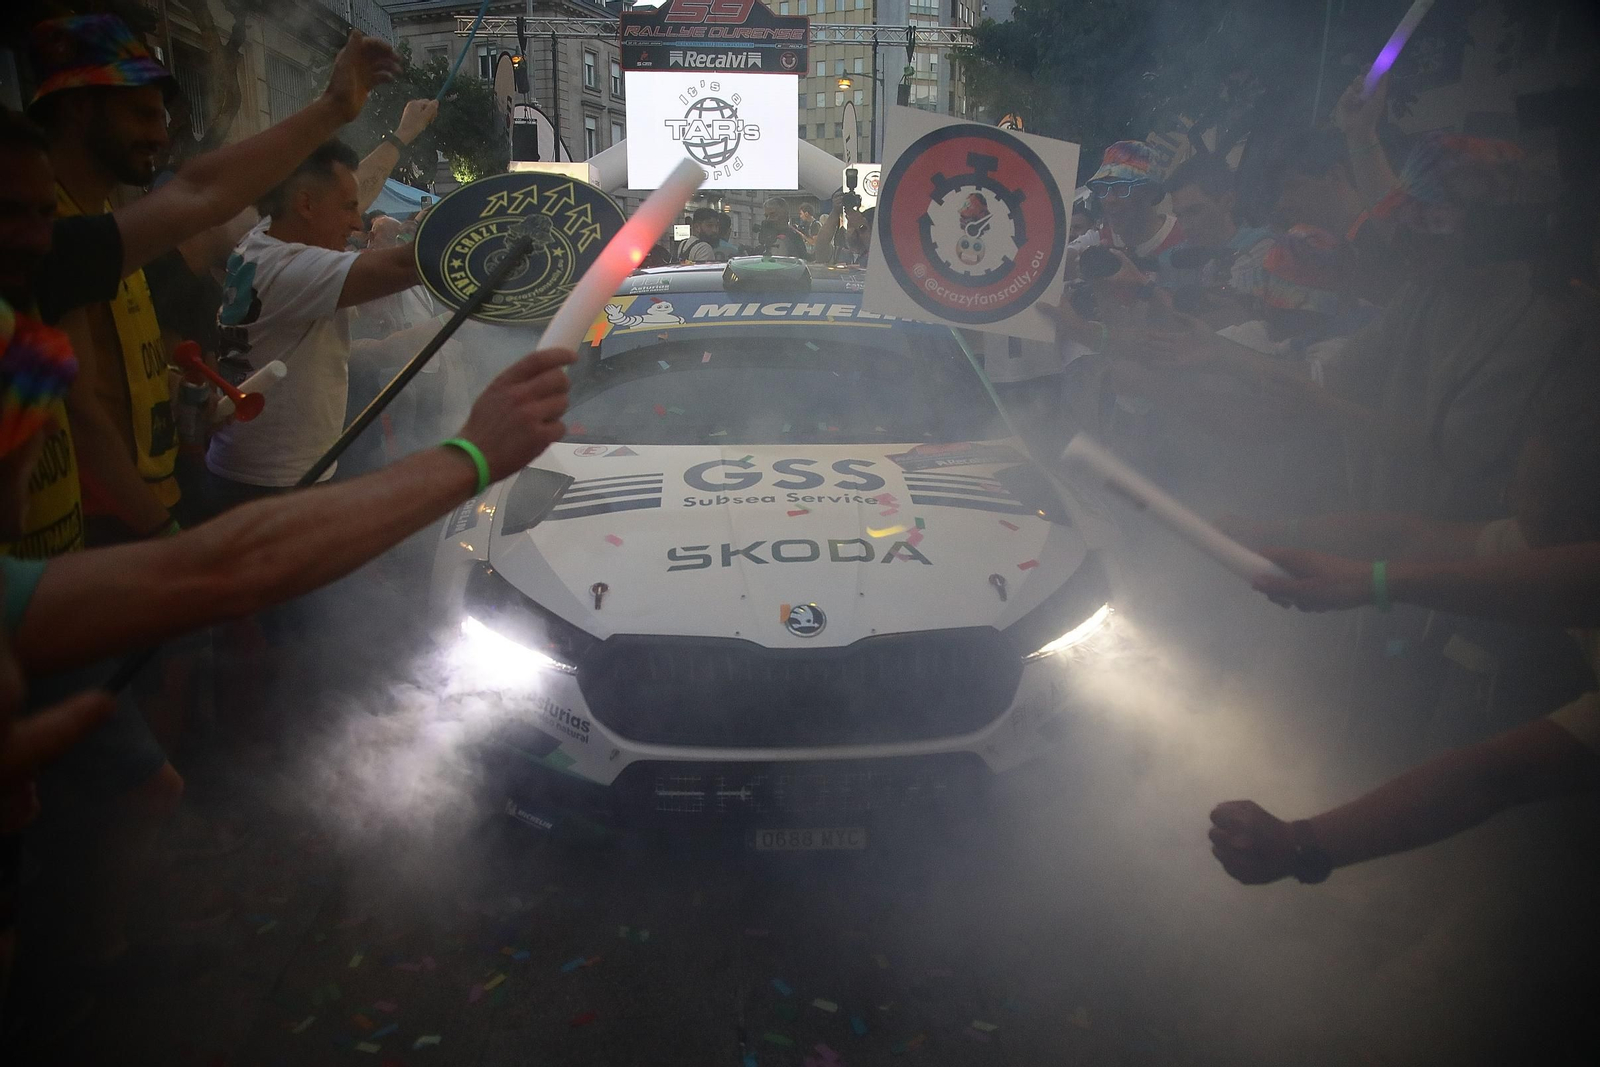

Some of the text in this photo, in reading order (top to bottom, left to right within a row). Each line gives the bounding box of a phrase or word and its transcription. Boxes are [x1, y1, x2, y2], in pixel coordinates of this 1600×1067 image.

[664, 0, 755, 24] 59
[624, 25, 806, 40] RALLYE OURENSE
[685, 51, 748, 69] Recalvi
[678, 79, 721, 106] It's
[664, 118, 761, 141] TAR's
[702, 156, 744, 181] orld
[455, 223, 498, 254] CRAZY
[924, 250, 1045, 308] @crazyfansrally_ou
[692, 302, 934, 325] MICHEL
[683, 458, 886, 492] GSS
[683, 494, 776, 507] Subsea
[531, 694, 591, 733] sturias
